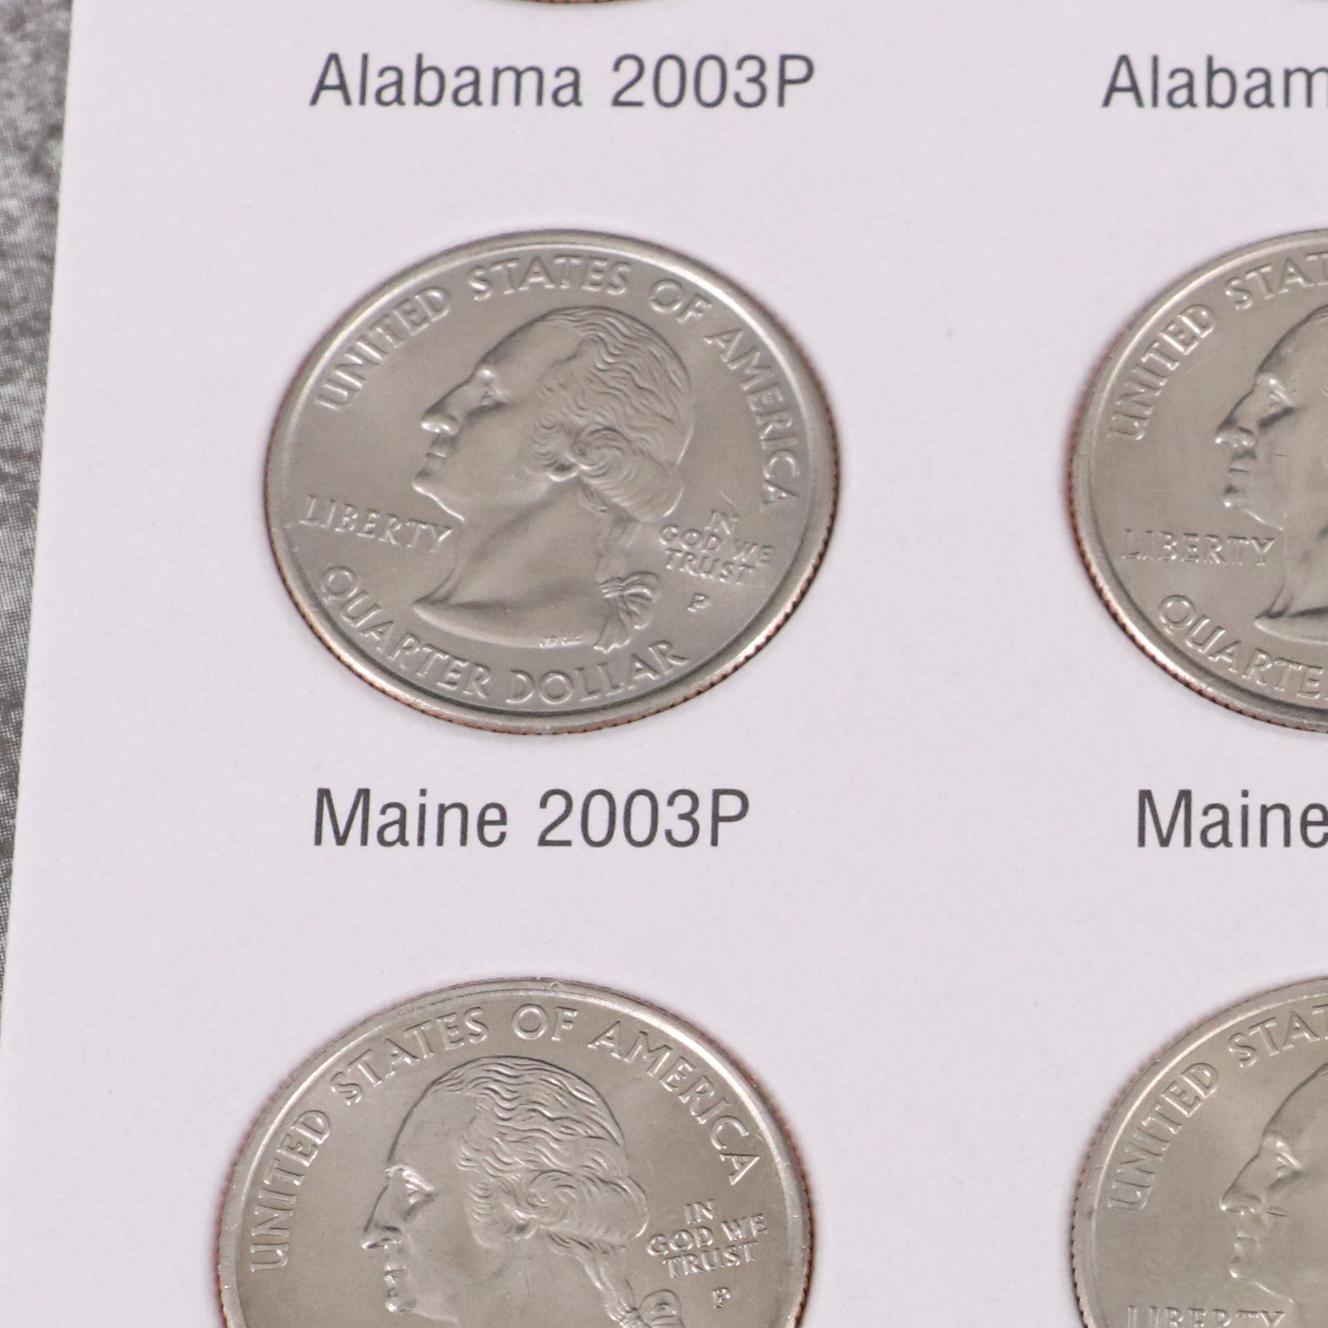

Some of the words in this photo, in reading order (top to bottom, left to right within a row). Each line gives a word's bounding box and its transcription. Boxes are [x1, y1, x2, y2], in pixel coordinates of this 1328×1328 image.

[310, 52, 582, 109] Alabama
[611, 54, 815, 109] 2003P
[317, 285, 451, 412] UNITED
[467, 254, 630, 302] STATES
[650, 280, 711, 324] OF
[705, 327, 799, 508] AMERICA
[1108, 303, 1215, 441] UNITED
[301, 495, 453, 551] LIBERTY
[660, 524, 724, 554] GOD
[734, 539, 773, 564] WE
[708, 510, 736, 534] IN
[1122, 529, 1275, 566] LIBERTY
[665, 550, 754, 586] TRUST
[320, 565, 492, 696] QUARTER
[506, 638, 690, 705] DOLLAR
[314, 787, 509, 848] Maine
[537, 788, 749, 848] 2003P
[251, 1109, 331, 1273] UNITED
[330, 1006, 488, 1106] STATES
[513, 1003, 578, 1041] OF
[588, 1022, 760, 1185] AMERICA
[1108, 1061, 1220, 1211] UNITED
[647, 1226, 713, 1258] GOD
[722, 1213, 767, 1242] WE
[683, 1200, 715, 1223] IN
[663, 1242, 757, 1277] TRUST
